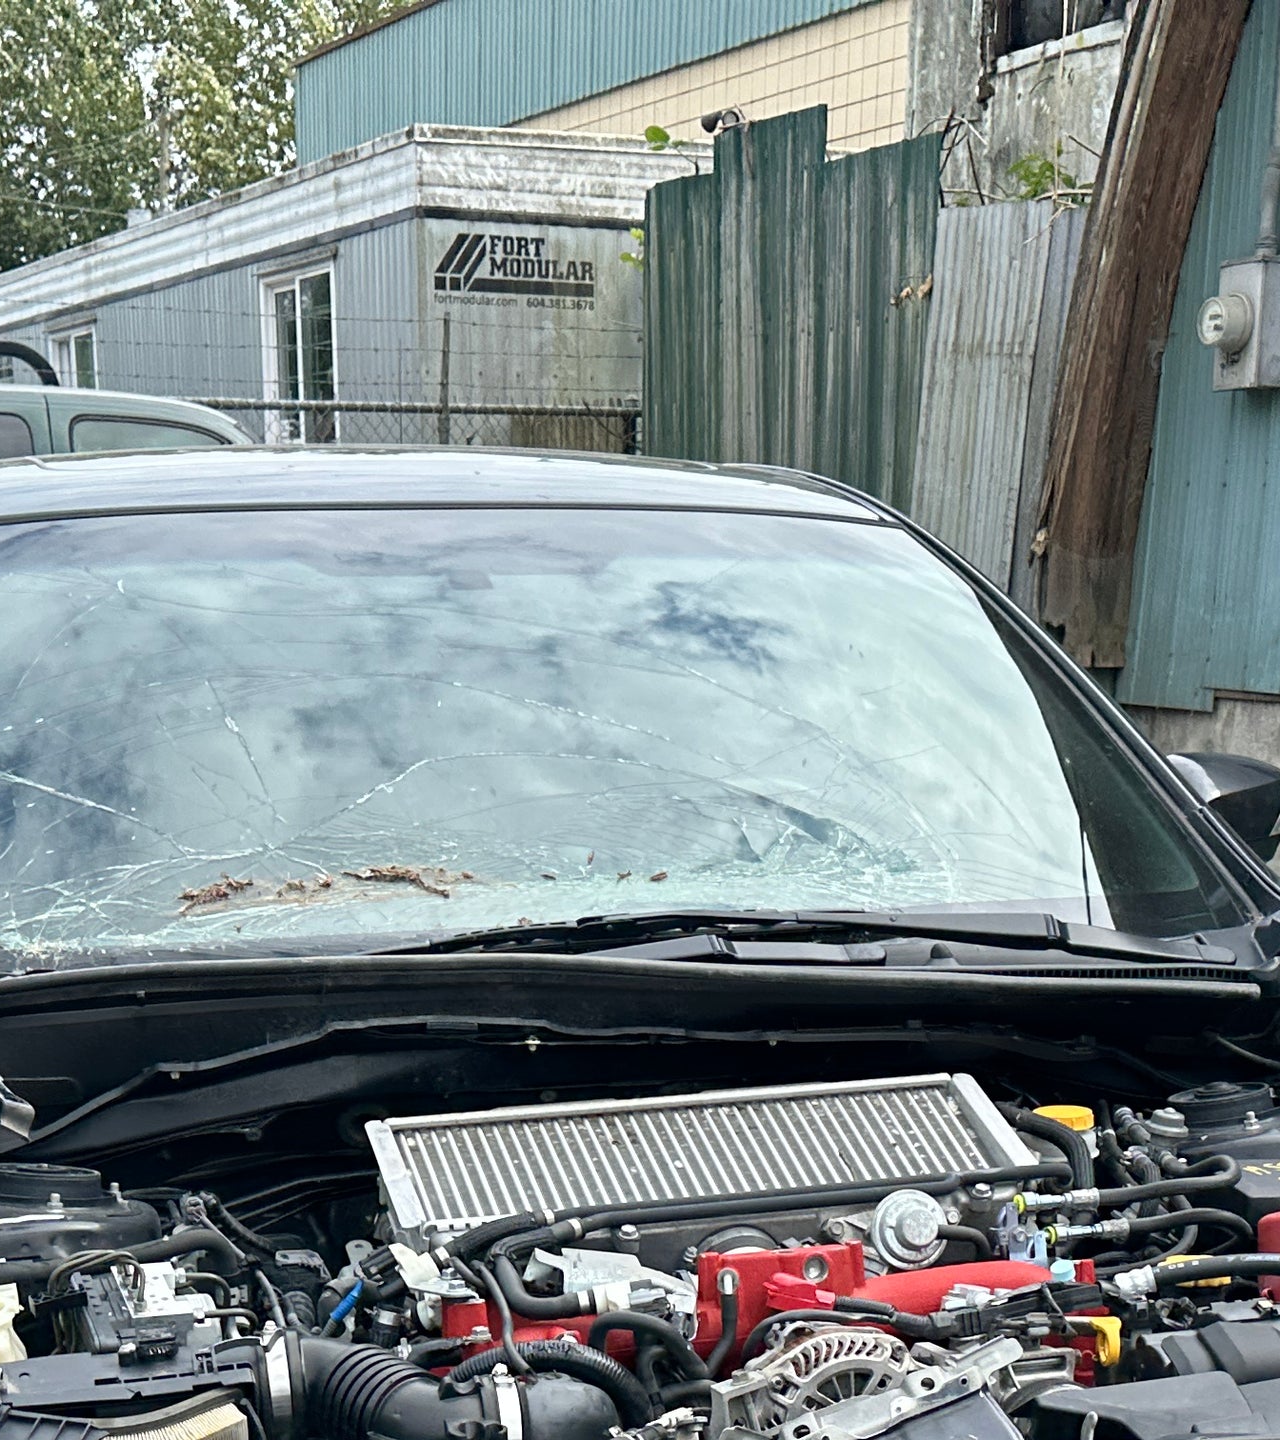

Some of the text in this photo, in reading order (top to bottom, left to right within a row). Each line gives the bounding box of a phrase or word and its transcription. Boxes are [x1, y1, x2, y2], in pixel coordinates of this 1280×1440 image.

[489, 234, 545, 257] FORT
[489, 256, 594, 282] MODULAR
[433, 292, 518, 308] fortmodular.com
